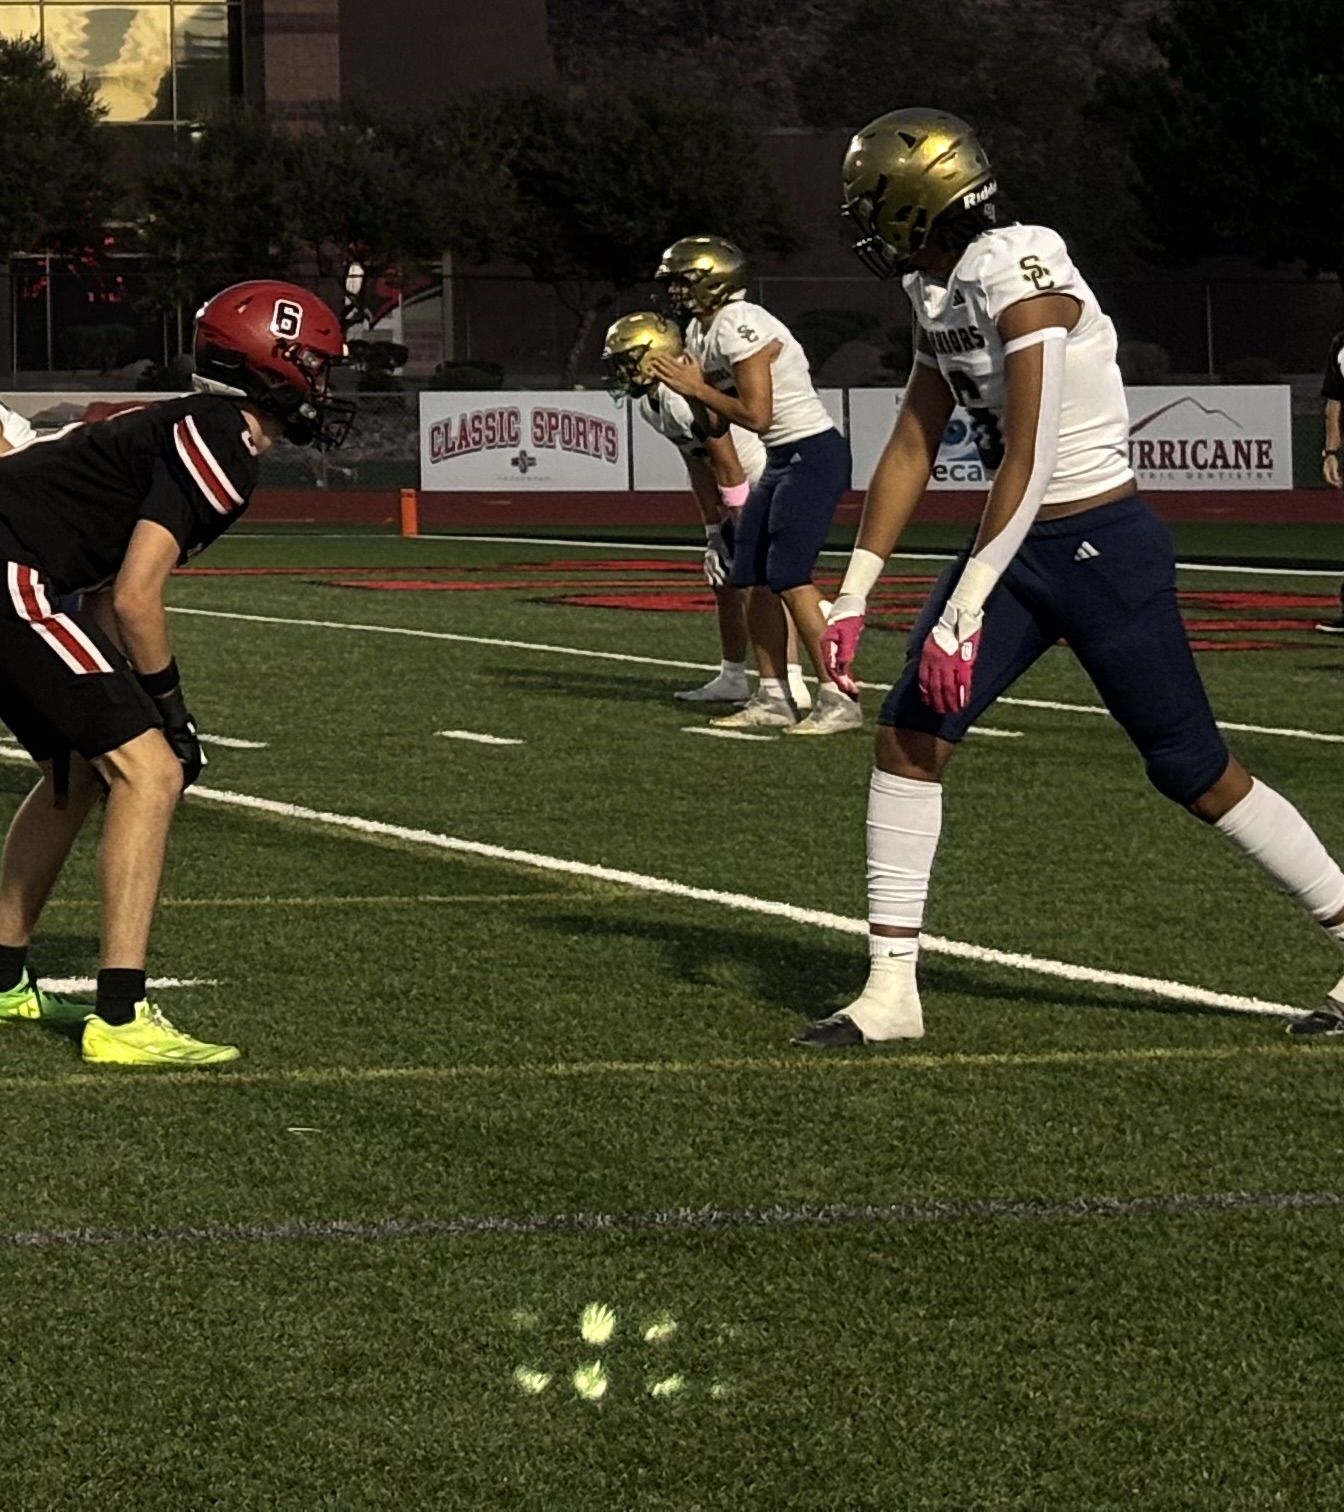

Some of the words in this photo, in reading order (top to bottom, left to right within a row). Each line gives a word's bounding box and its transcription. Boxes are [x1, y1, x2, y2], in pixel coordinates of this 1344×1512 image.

[270, 299, 303, 340] 6
[430, 407, 520, 464] CLASSIC
[531, 407, 619, 464] SPORTS
